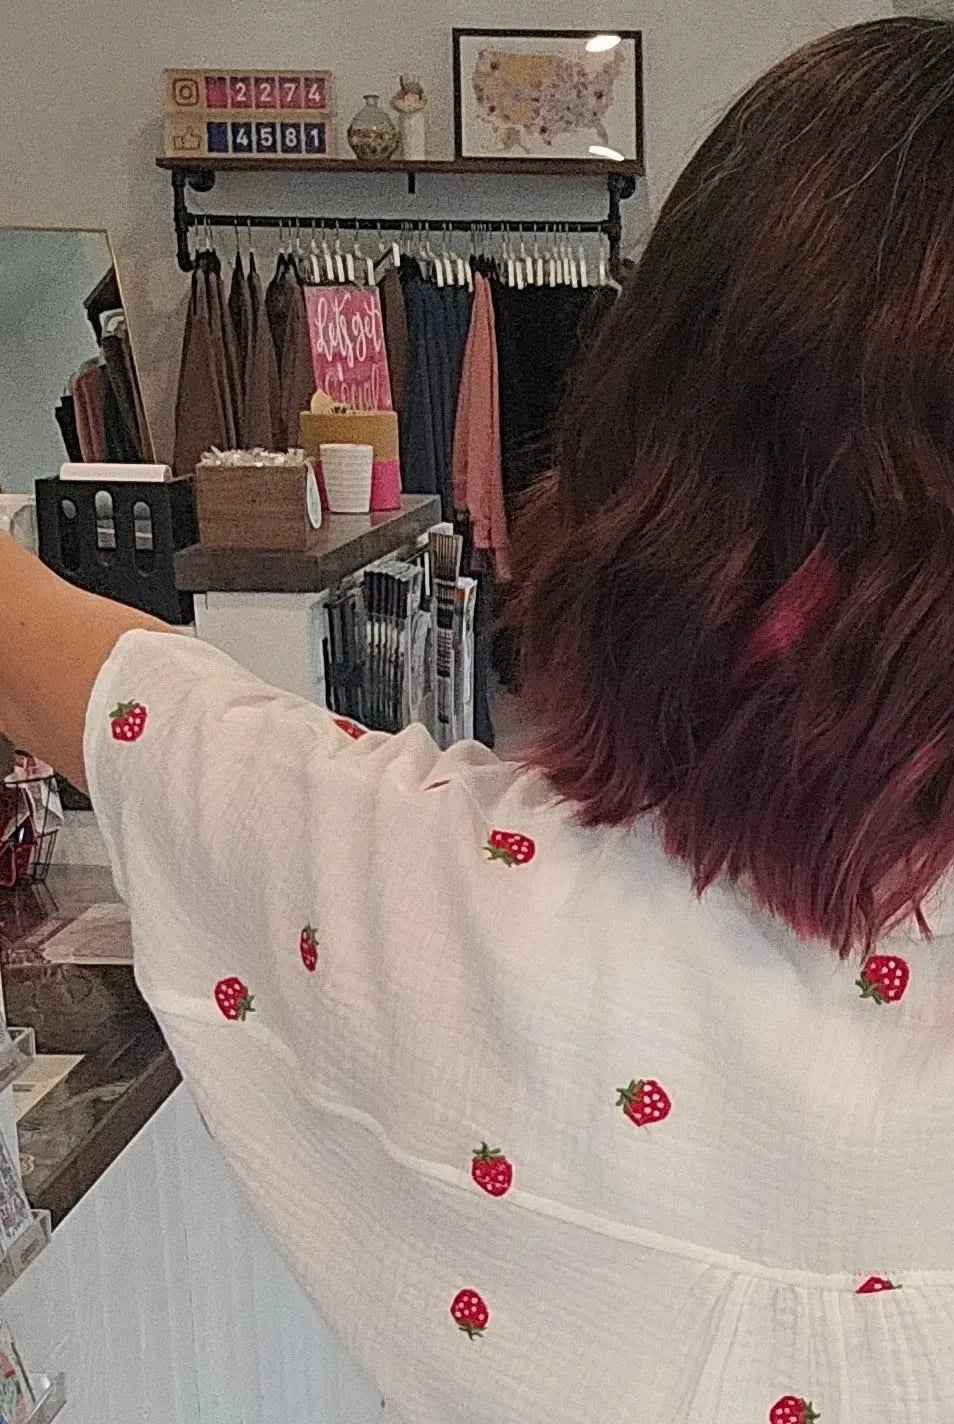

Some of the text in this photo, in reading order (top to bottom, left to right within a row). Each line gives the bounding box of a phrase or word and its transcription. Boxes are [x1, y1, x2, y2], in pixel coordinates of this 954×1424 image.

[235, 83, 321, 102] 2274
[235, 128, 321, 147] 4581
[352, 296, 381, 361] get
